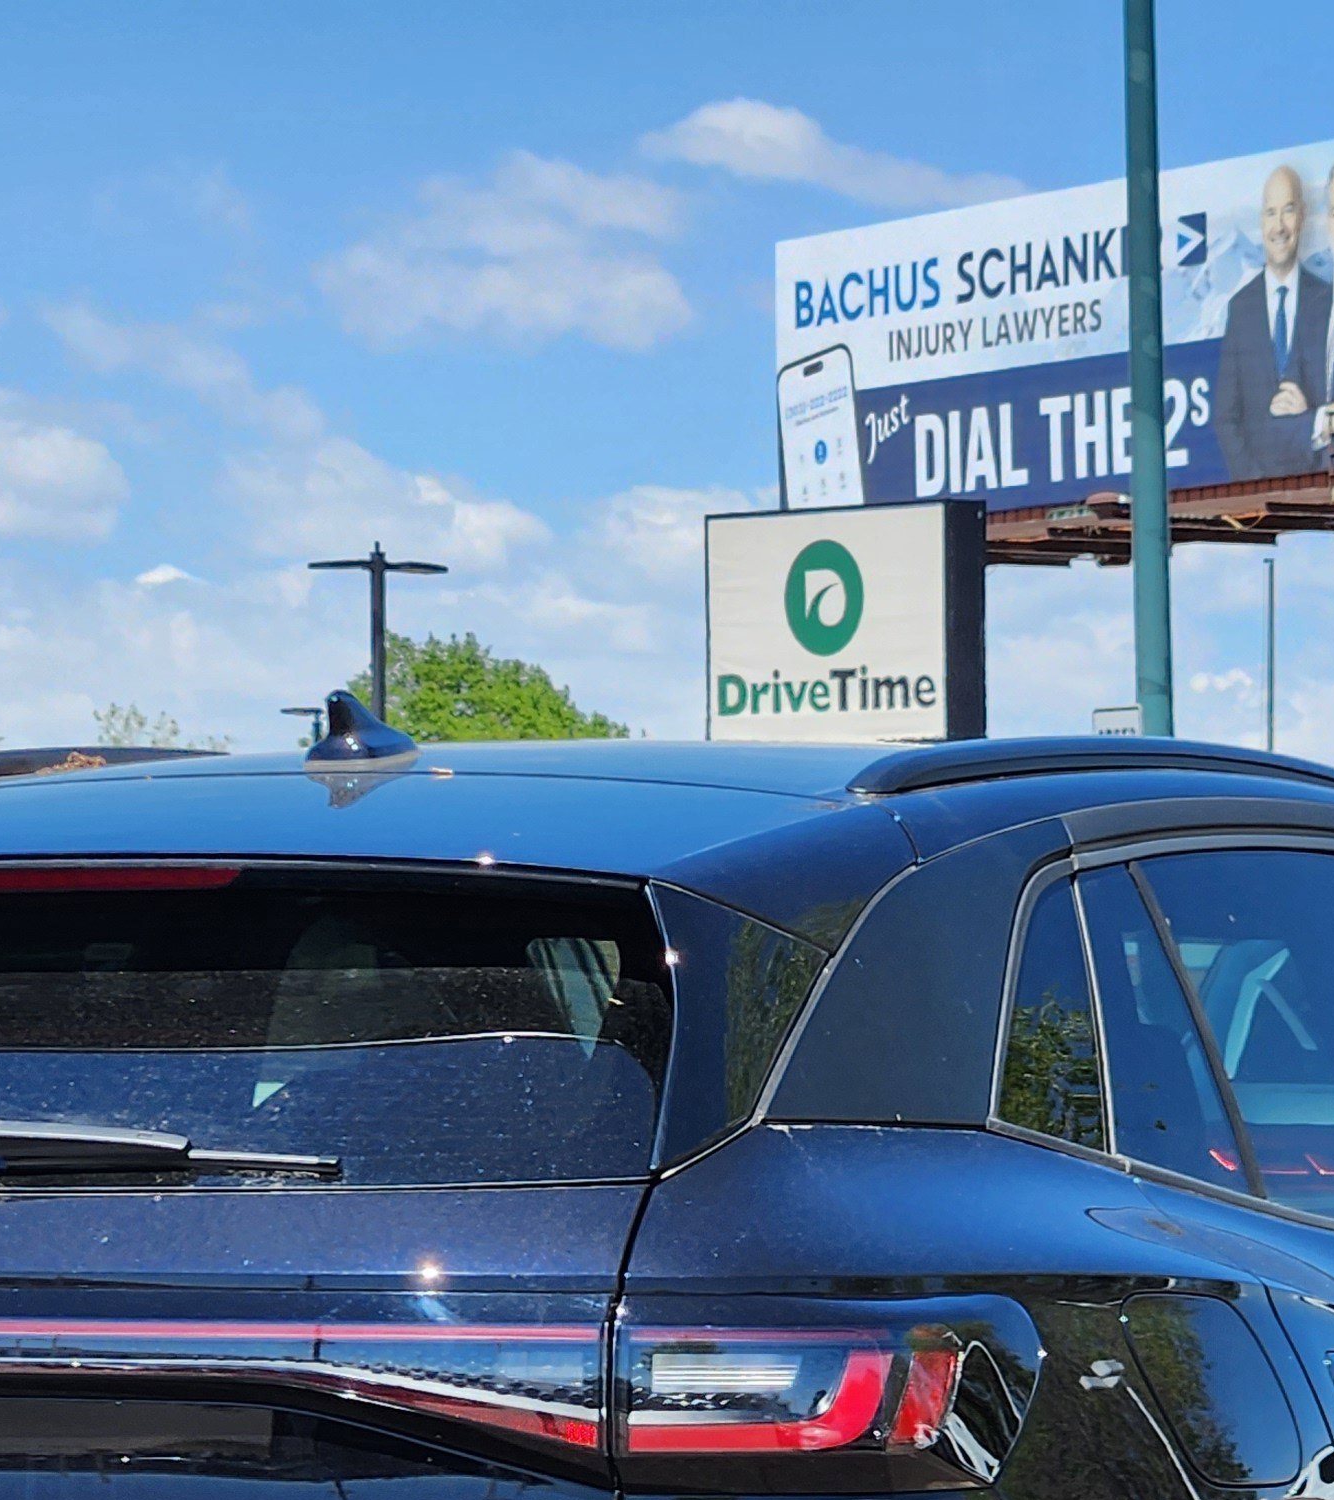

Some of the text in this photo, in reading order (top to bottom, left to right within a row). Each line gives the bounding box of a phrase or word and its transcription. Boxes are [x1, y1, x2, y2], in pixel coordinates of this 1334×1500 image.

[795, 224, 1163, 329] BACHUS SCHANK
[888, 299, 1102, 362] INJURY LAWYERS
[864, 393, 910, 465] Just
[914, 402, 1029, 498] DIAL
[1039, 386, 1133, 482] THE
[717, 664, 937, 716] DriveTime
